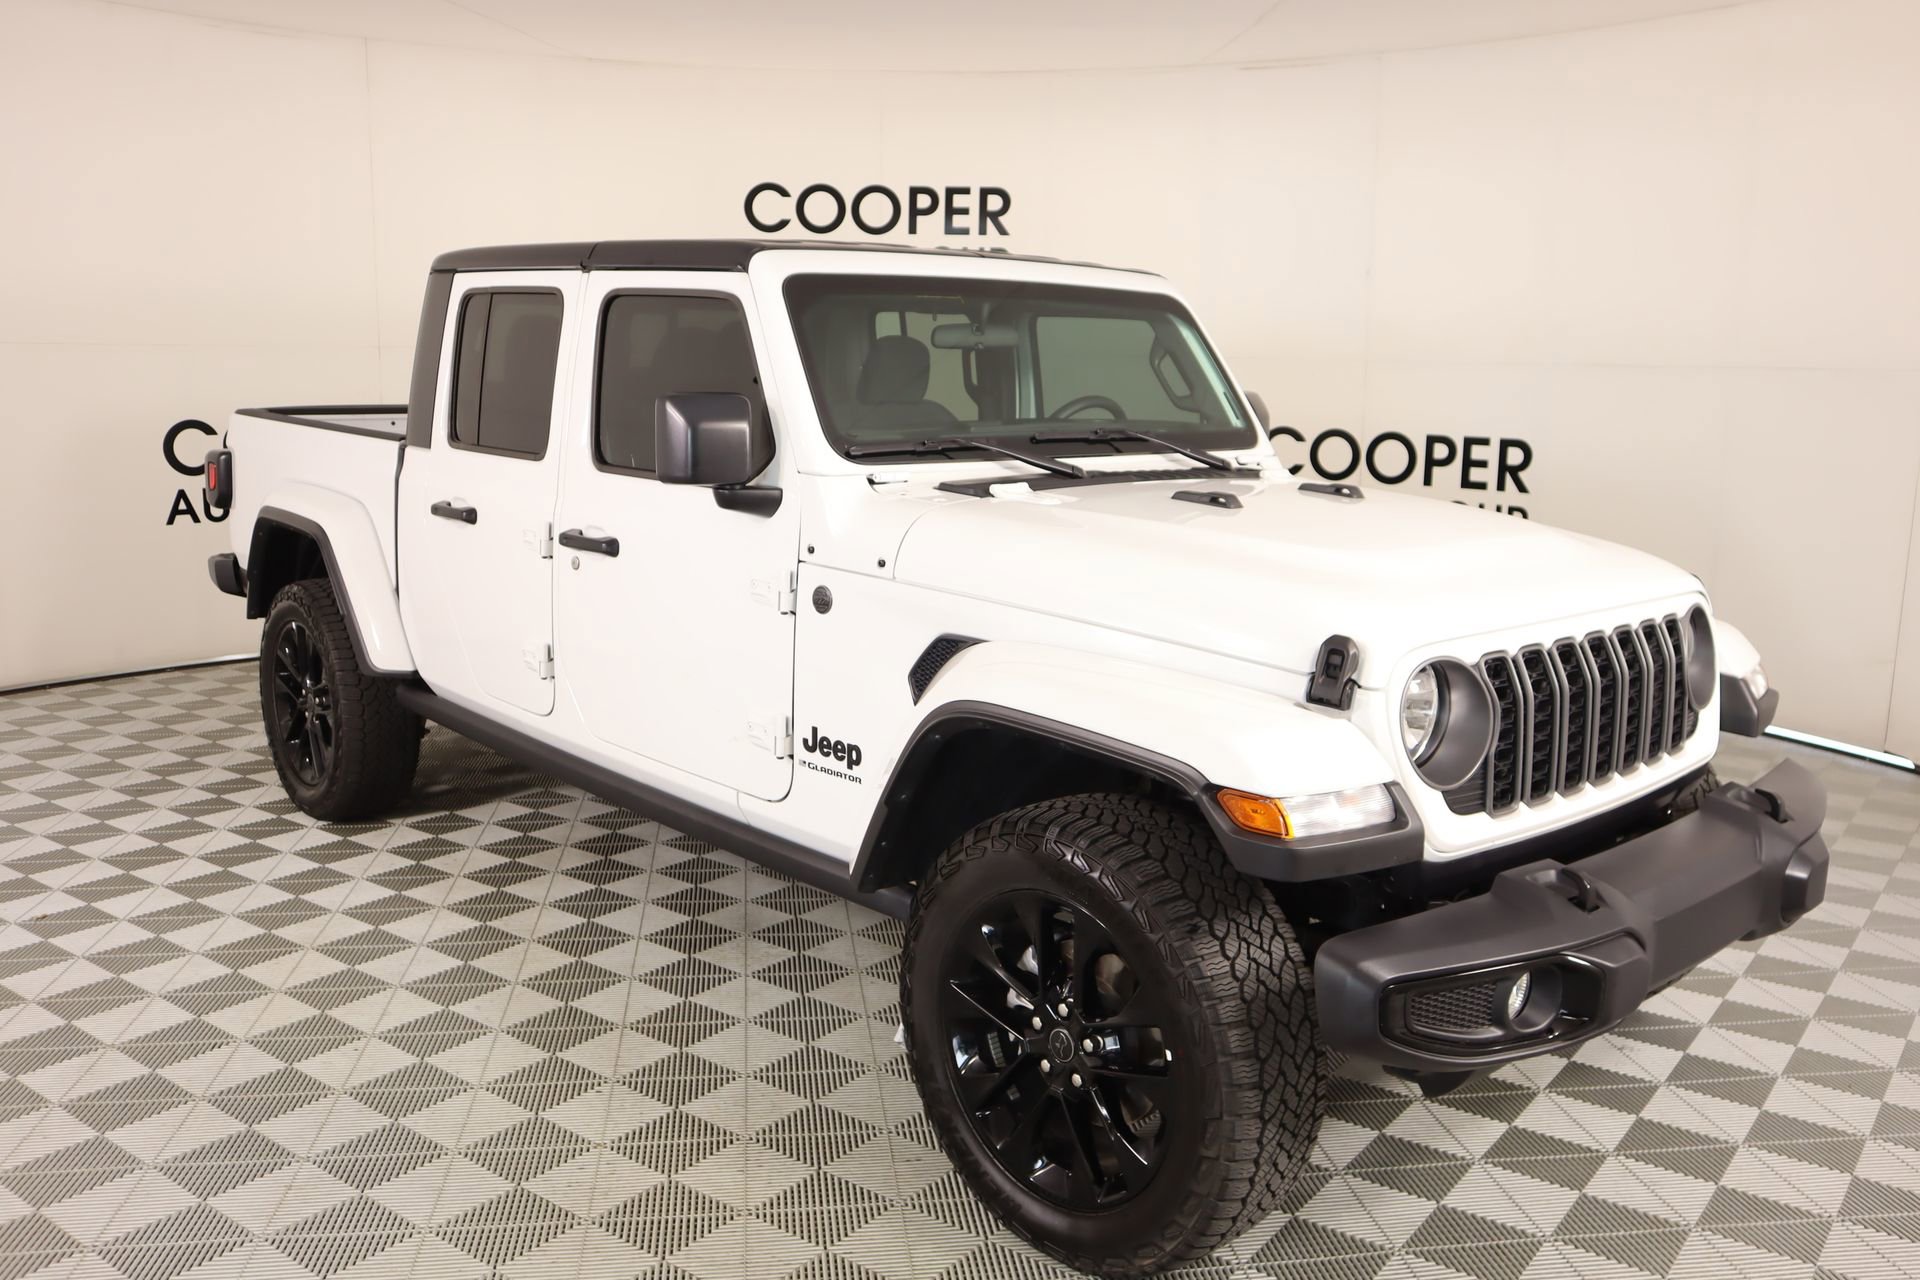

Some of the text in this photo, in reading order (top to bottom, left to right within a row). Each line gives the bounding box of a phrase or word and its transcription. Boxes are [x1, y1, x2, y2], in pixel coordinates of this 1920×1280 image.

[744, 182, 1011, 235] COOPER
[802, 725, 862, 771] Jeep
[807, 761, 862, 785] GLADIATOR
